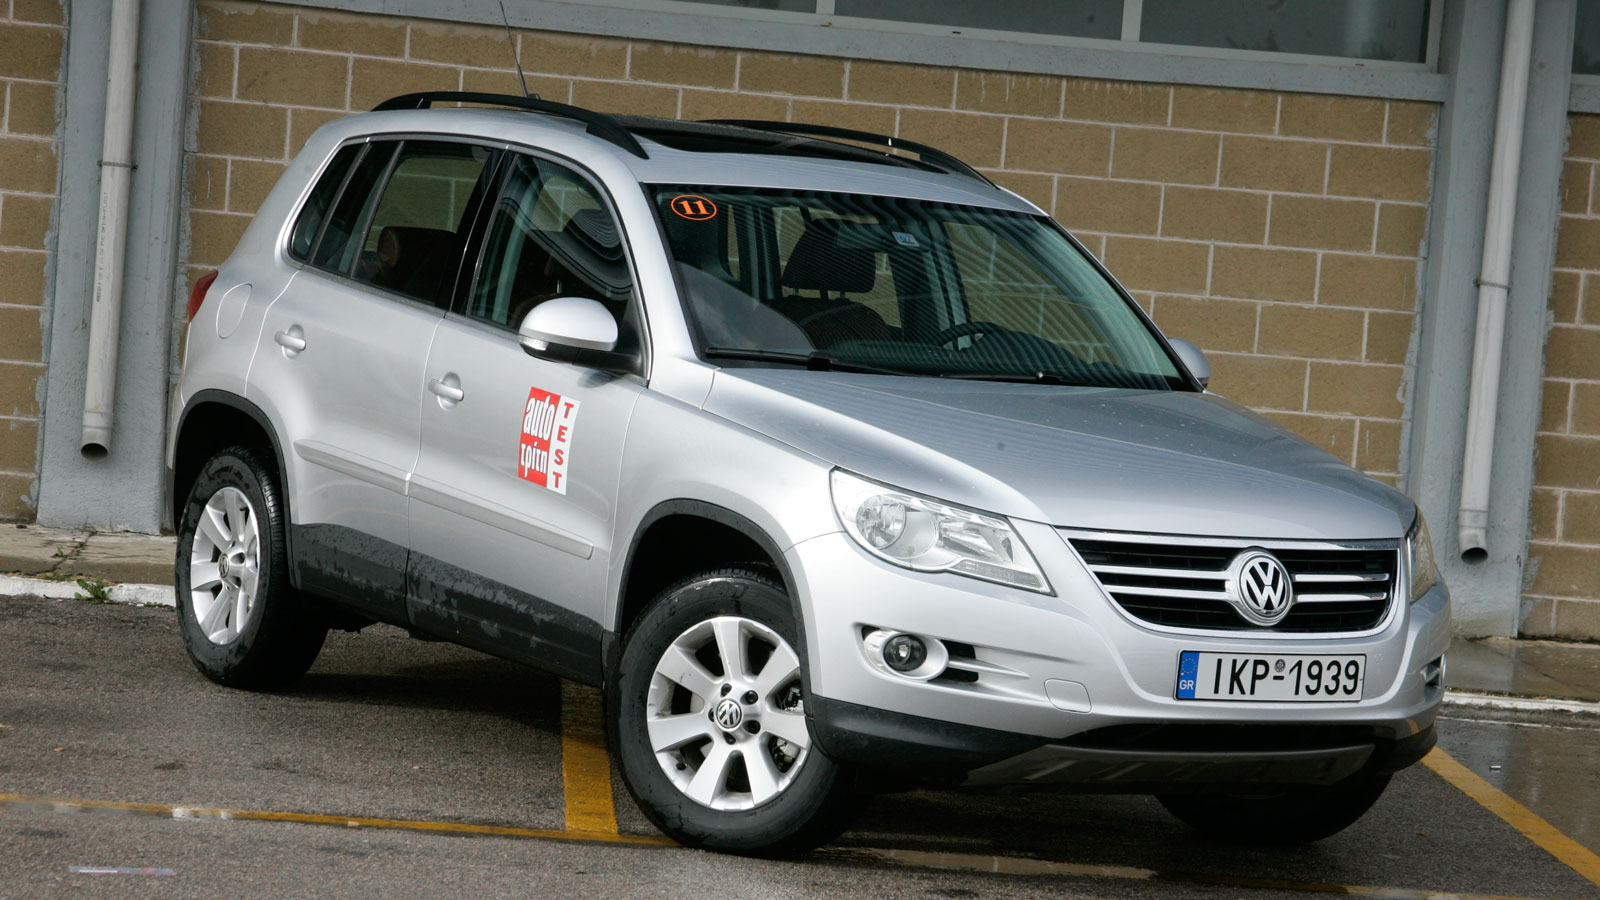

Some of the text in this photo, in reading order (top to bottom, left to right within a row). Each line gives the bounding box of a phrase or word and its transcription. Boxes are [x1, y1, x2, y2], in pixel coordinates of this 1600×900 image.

[677, 200, 712, 216] 11
[523, 395, 556, 441] auto
[552, 402, 574, 489] TEST
[1240, 556, 1289, 615] VW
[1179, 679, 1194, 691] GR
[1213, 658, 1360, 696] IKP-1939
